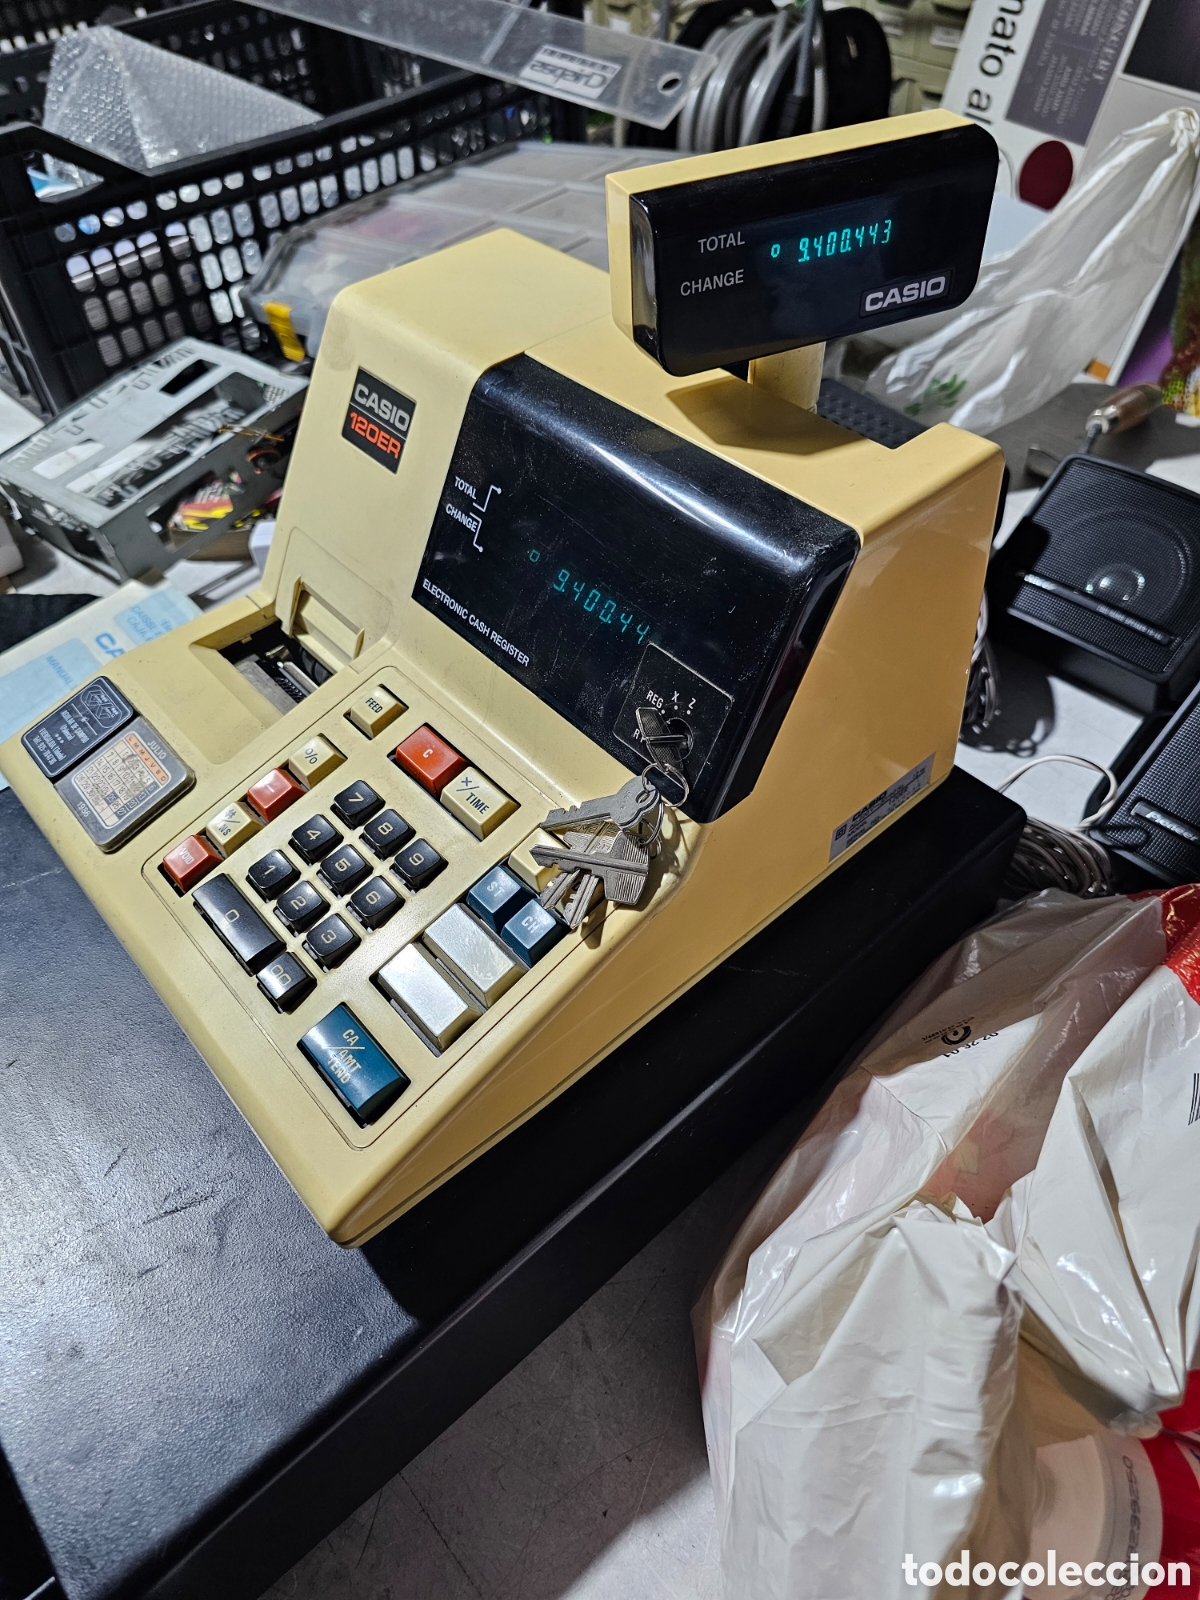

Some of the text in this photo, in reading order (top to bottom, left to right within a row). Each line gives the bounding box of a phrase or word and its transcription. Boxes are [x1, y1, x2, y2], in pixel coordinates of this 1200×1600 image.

[698, 231, 745, 253] TOTAL
[680, 269, 744, 296] CHANGE
[865, 277, 946, 312] CASIO
[354, 383, 410, 432] CASIO
[350, 411, 402, 459] 120ER
[454, 476, 477, 499] TOTAL
[445, 503, 478, 532] CHANGE
[422, 578, 530, 667] ELECTRONIC CASH REGISTER
[46, 655, 73, 685] MANUAL
[365, 697, 383, 713] FEED
[646, 690, 663, 708] REG
[671, 690, 680, 703] X
[688, 697, 697, 709] Z
[147, 740, 167, 760] JULIO
[304, 747, 318, 765] %
[422, 748, 434, 759] C
[122, 771, 130, 779] 10
[81, 781, 89, 789] 29
[86, 788, 95, 796] 30
[91, 773, 100, 781] 22
[107, 793, 115, 802] 25
[117, 807, 126, 815] 27
[349, 792, 364, 801] 7
[76, 801, 91, 817] 1986
[128, 799, 136, 807] 20
[466, 792, 490, 815] TIME
[852, 790, 887, 821] CASIO
[218, 824, 232, 836] NS
[377, 822, 394, 835] 8
[1145, 810, 1198, 841] Pioneer
[307, 829, 321, 840] 4
[179, 848, 195, 865] VOID
[334, 857, 351, 872] 5
[408, 853, 424, 866] 9
[264, 865, 276, 875] 1
[366, 890, 381, 904] 6
[486, 881, 505, 898] ST
[290, 896, 306, 910] 2
[224, 909, 239, 923] 0
[521, 918, 540, 934] CH
[321, 930, 337, 944] 3
[270, 964, 292, 986] 00
[342, 1029, 360, 1046] CA
[326, 1054, 351, 1084] TEND
[337, 1049, 362, 1073] AMT
